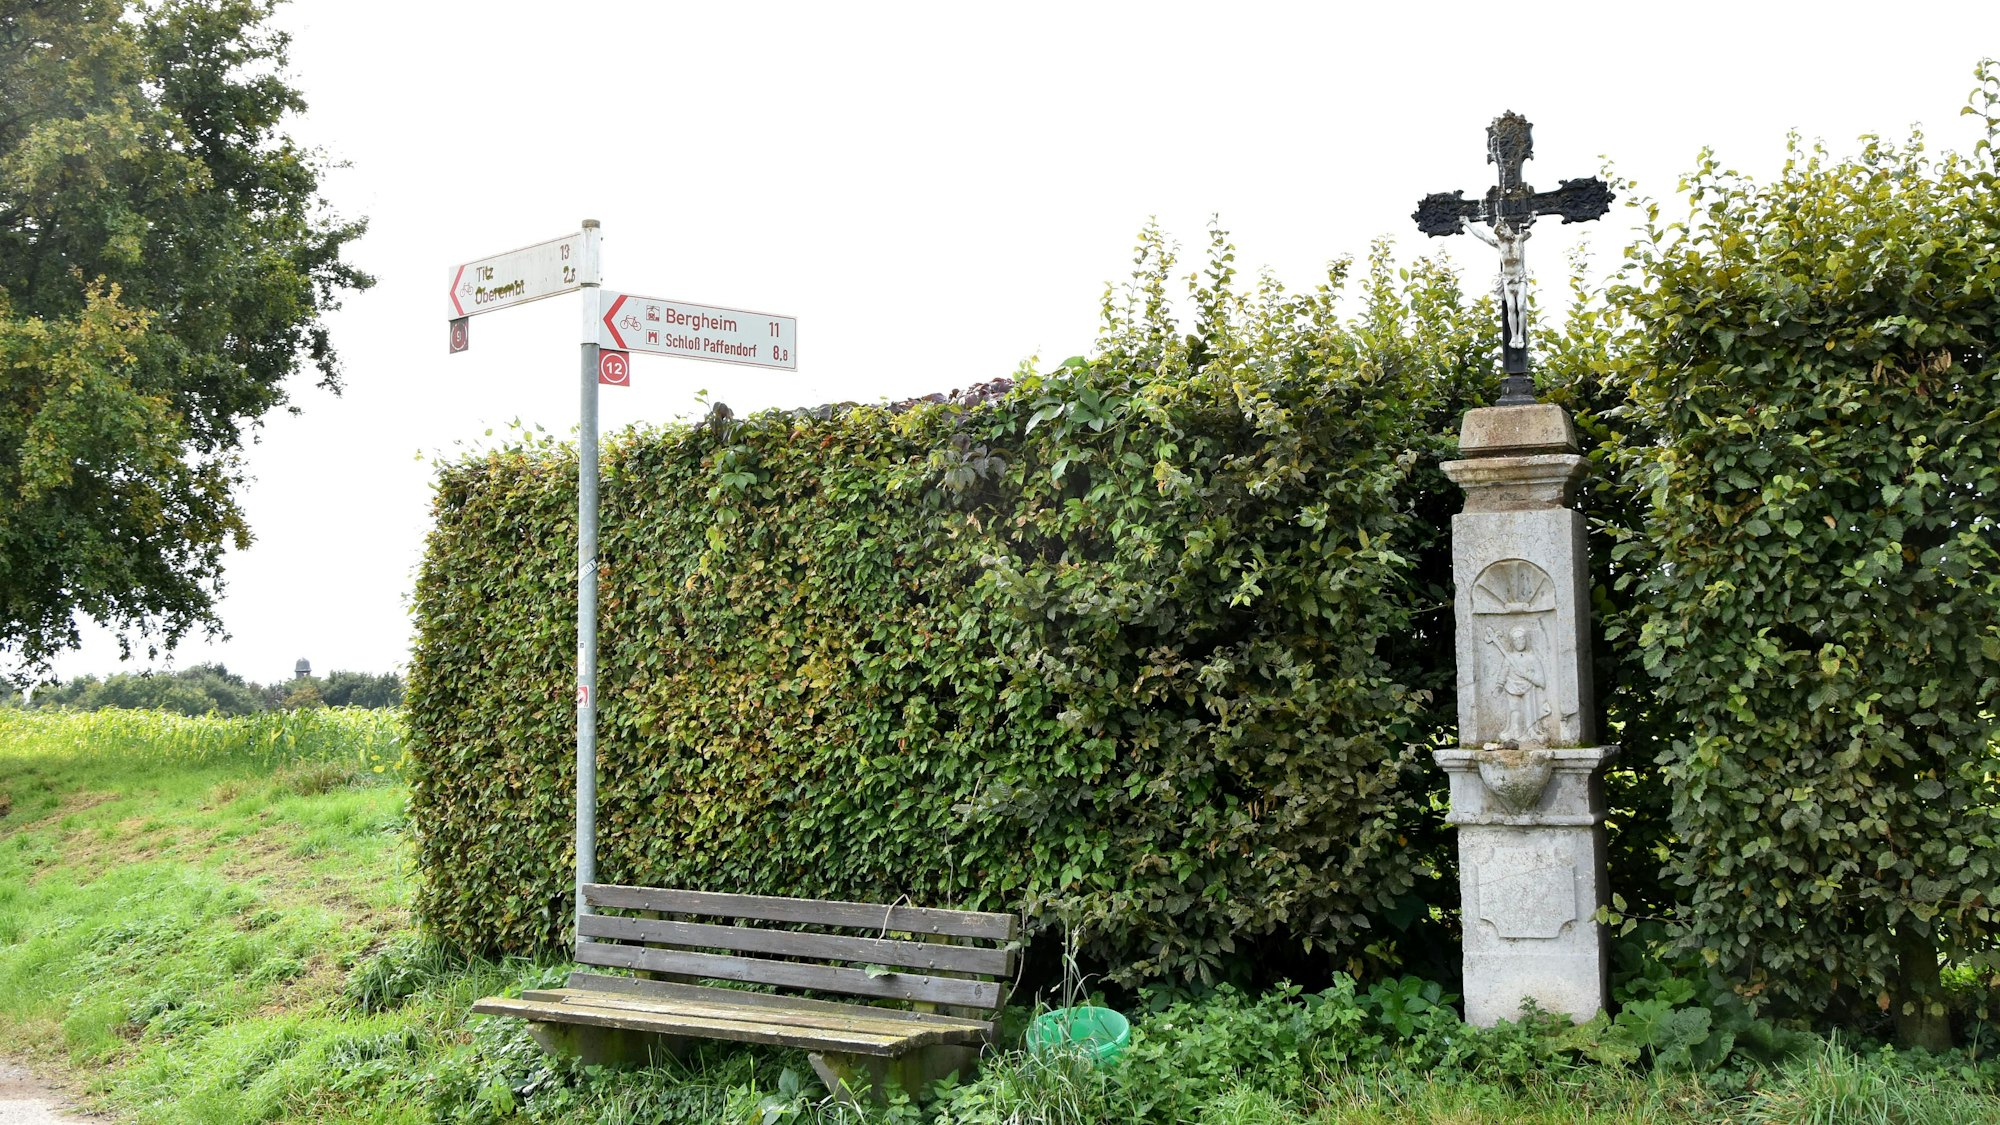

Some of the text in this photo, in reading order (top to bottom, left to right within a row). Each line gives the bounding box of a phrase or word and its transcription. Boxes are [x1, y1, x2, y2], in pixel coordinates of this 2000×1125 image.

[476, 244, 570, 282] Titz 13
[475, 279, 525, 304] Oberembt
[666, 308, 780, 337] Bergheim 11
[665, 333, 788, 361] Schloß Paffendorf 8,8
[606, 362, 623, 375] 12
